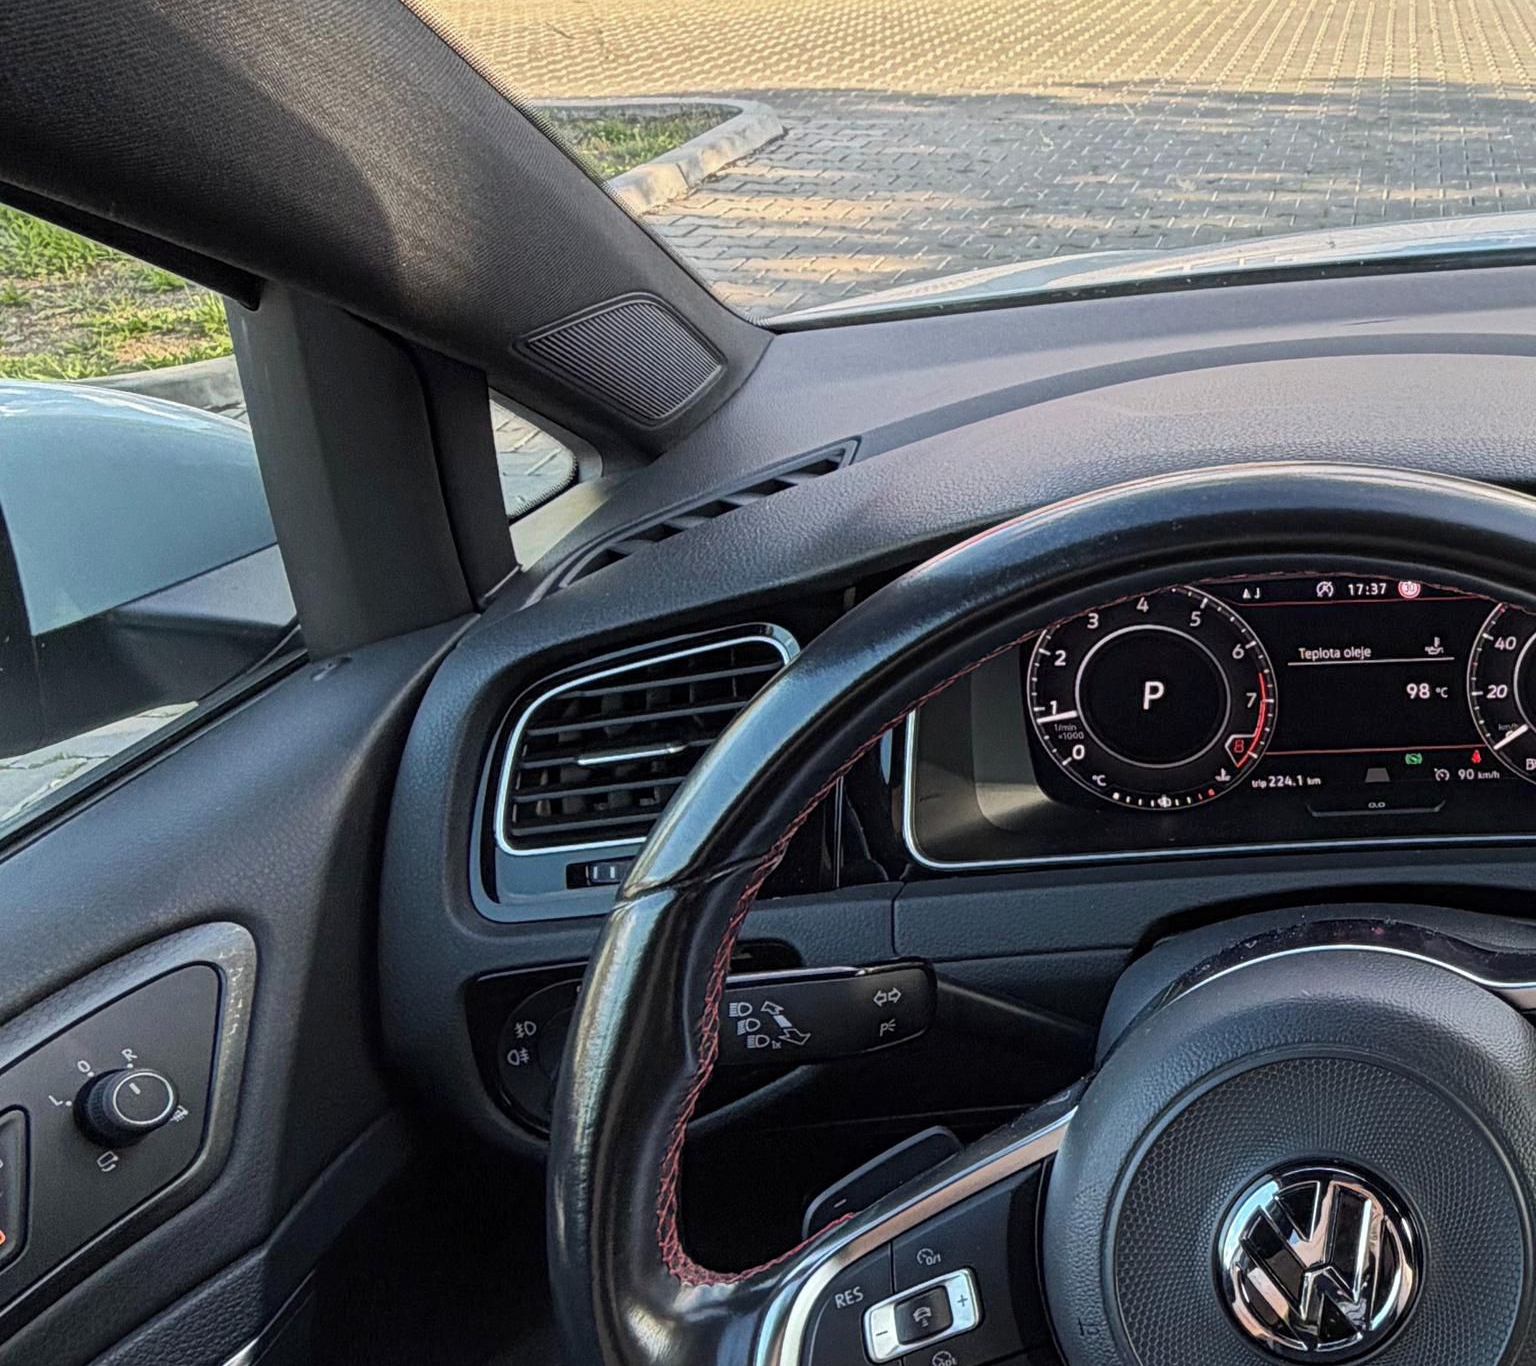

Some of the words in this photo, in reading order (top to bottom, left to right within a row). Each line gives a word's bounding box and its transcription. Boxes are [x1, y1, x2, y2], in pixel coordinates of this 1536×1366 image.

[1348, 583, 1388, 596] 17:37
[1136, 597, 1149, 613] 4
[1087, 613, 1100, 629] 3
[1190, 611, 1201, 627] 5
[1232, 644, 1245, 659] 6
[1494, 636, 1517, 651] 40
[1054, 650, 1067, 666] 2
[1299, 647, 1341, 662] Teplota
[1344, 646, 1372, 660] oleje
[1143, 681, 1165, 710] P
[1406, 683, 1431, 699] 98
[1486, 685, 1508, 699] 20
[1049, 700, 1058, 715] 1
[1246, 692, 1258, 709] 7
[1072, 744, 1086, 761] 0
[1234, 740, 1245, 753] 8
[1092, 774, 1107, 786] °C
[1251, 778, 1267, 790] trip
[1268, 774, 1303, 787] 224.1
[1307, 776, 1321, 786] km
[1457, 768, 1475, 780] 90
[1477, 770, 1500, 781] km/h
[834, 1286, 864, 1309] RES
